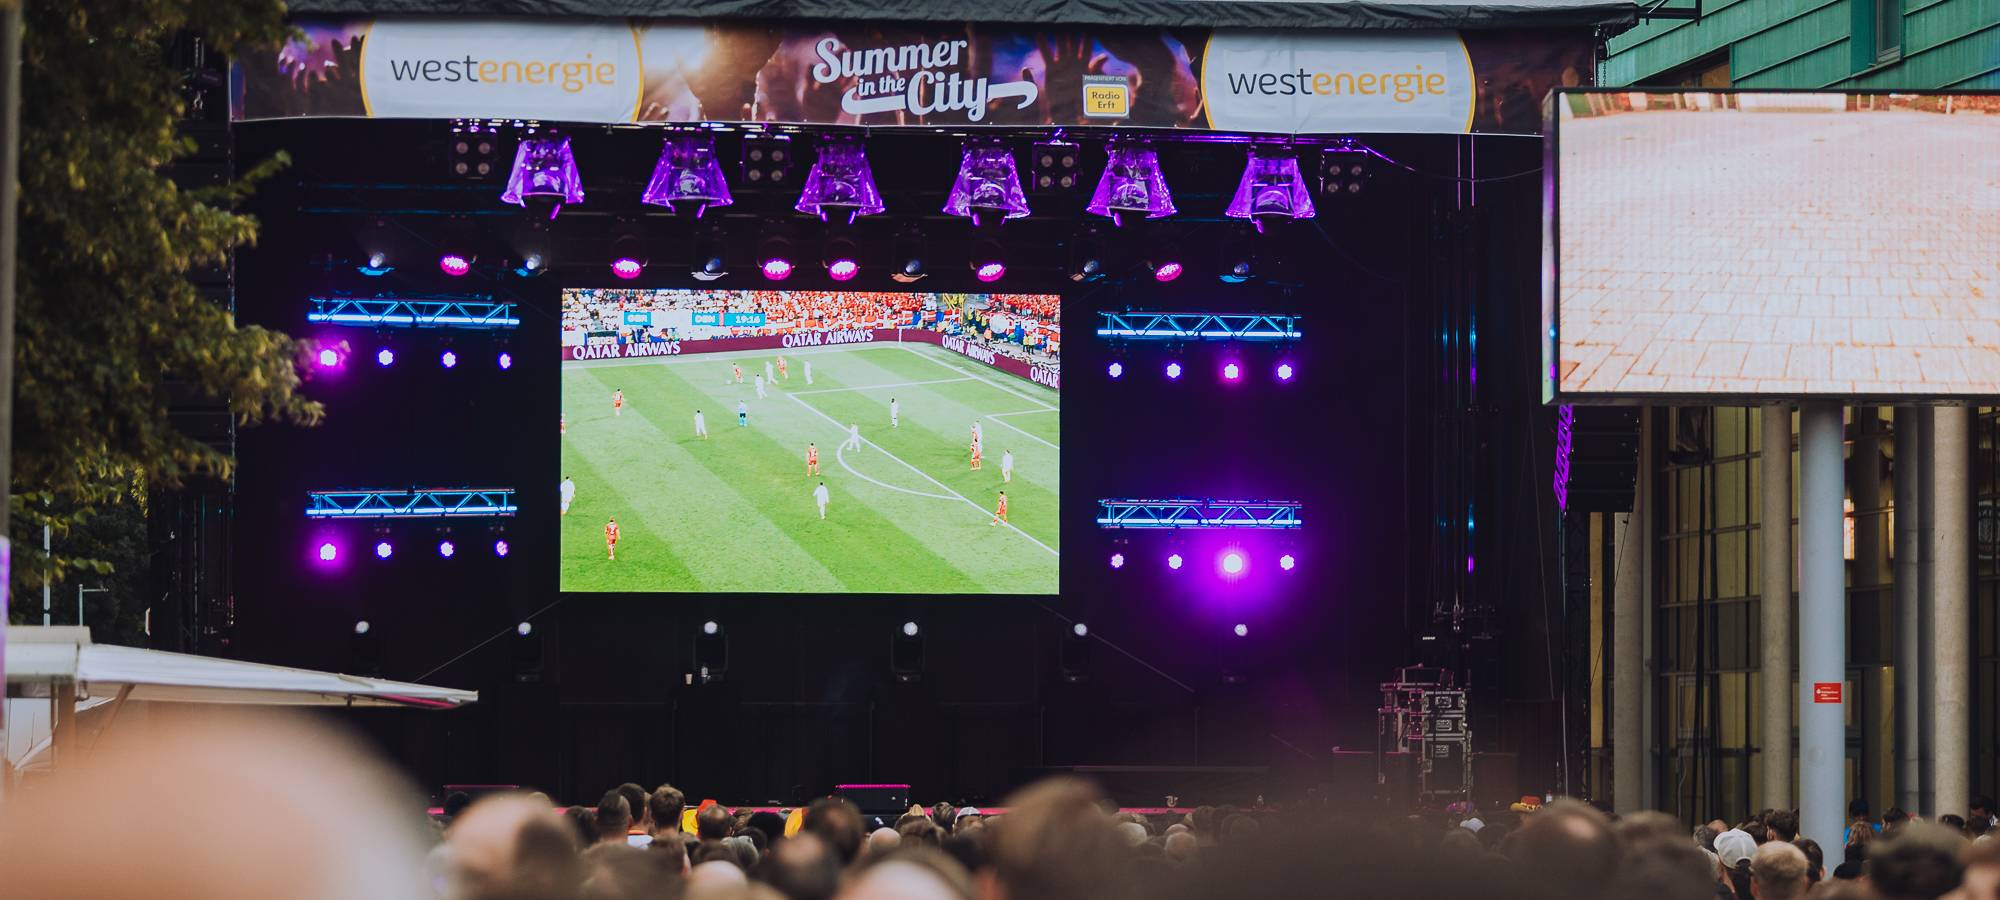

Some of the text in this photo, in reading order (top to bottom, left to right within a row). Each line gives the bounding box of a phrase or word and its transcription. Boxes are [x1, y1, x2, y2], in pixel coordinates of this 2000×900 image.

[390, 53, 615, 93] westenergie
[812, 37, 967, 84] Summer
[858, 71, 988, 122] in the City
[1092, 91, 1120, 100] Radio
[1228, 64, 1446, 103] westenergie
[1097, 101, 1115, 109] Erft
[573, 344, 620, 361] QATAR
[625, 341, 681, 357] AIRWAYS
[782, 330, 874, 348] QATAR AIRWAYS
[941, 334, 996, 365] QATAR AIRWAYS
[1030, 366, 1060, 389] QATAR
